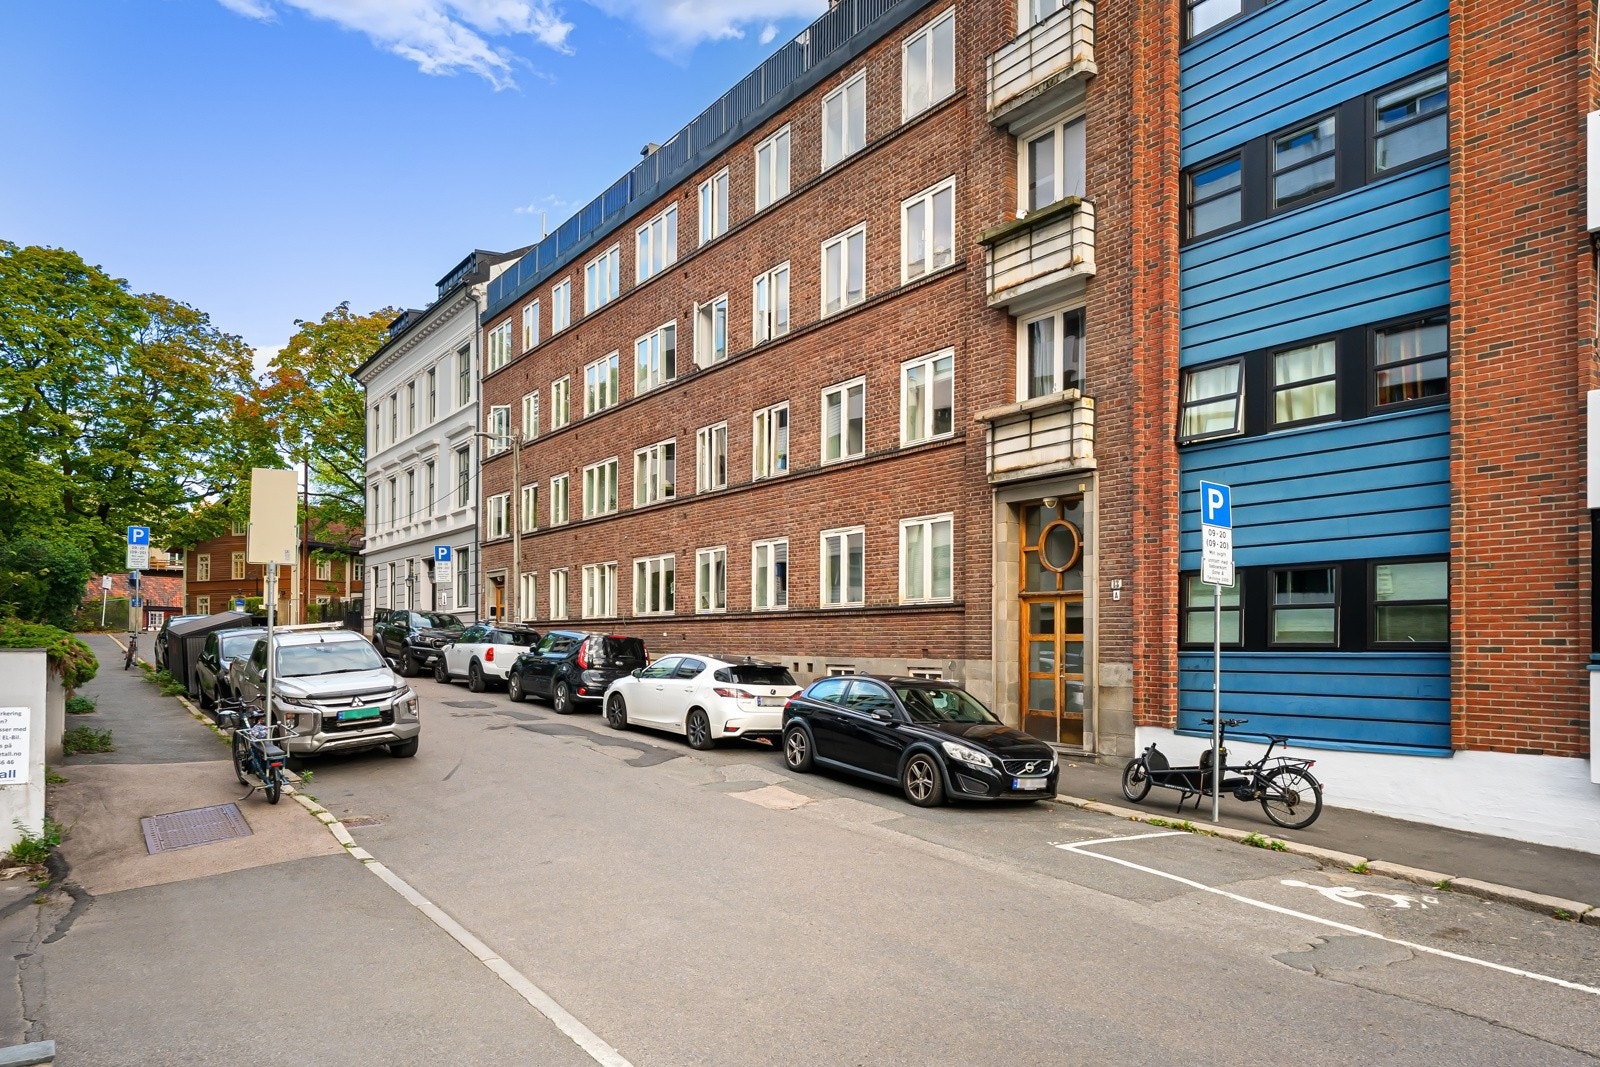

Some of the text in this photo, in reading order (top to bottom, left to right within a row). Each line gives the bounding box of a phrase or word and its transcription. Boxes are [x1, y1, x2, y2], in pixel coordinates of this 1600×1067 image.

[1208, 488, 1224, 520] P
[132, 528, 145, 543] P
[438, 547, 448, 560] P
